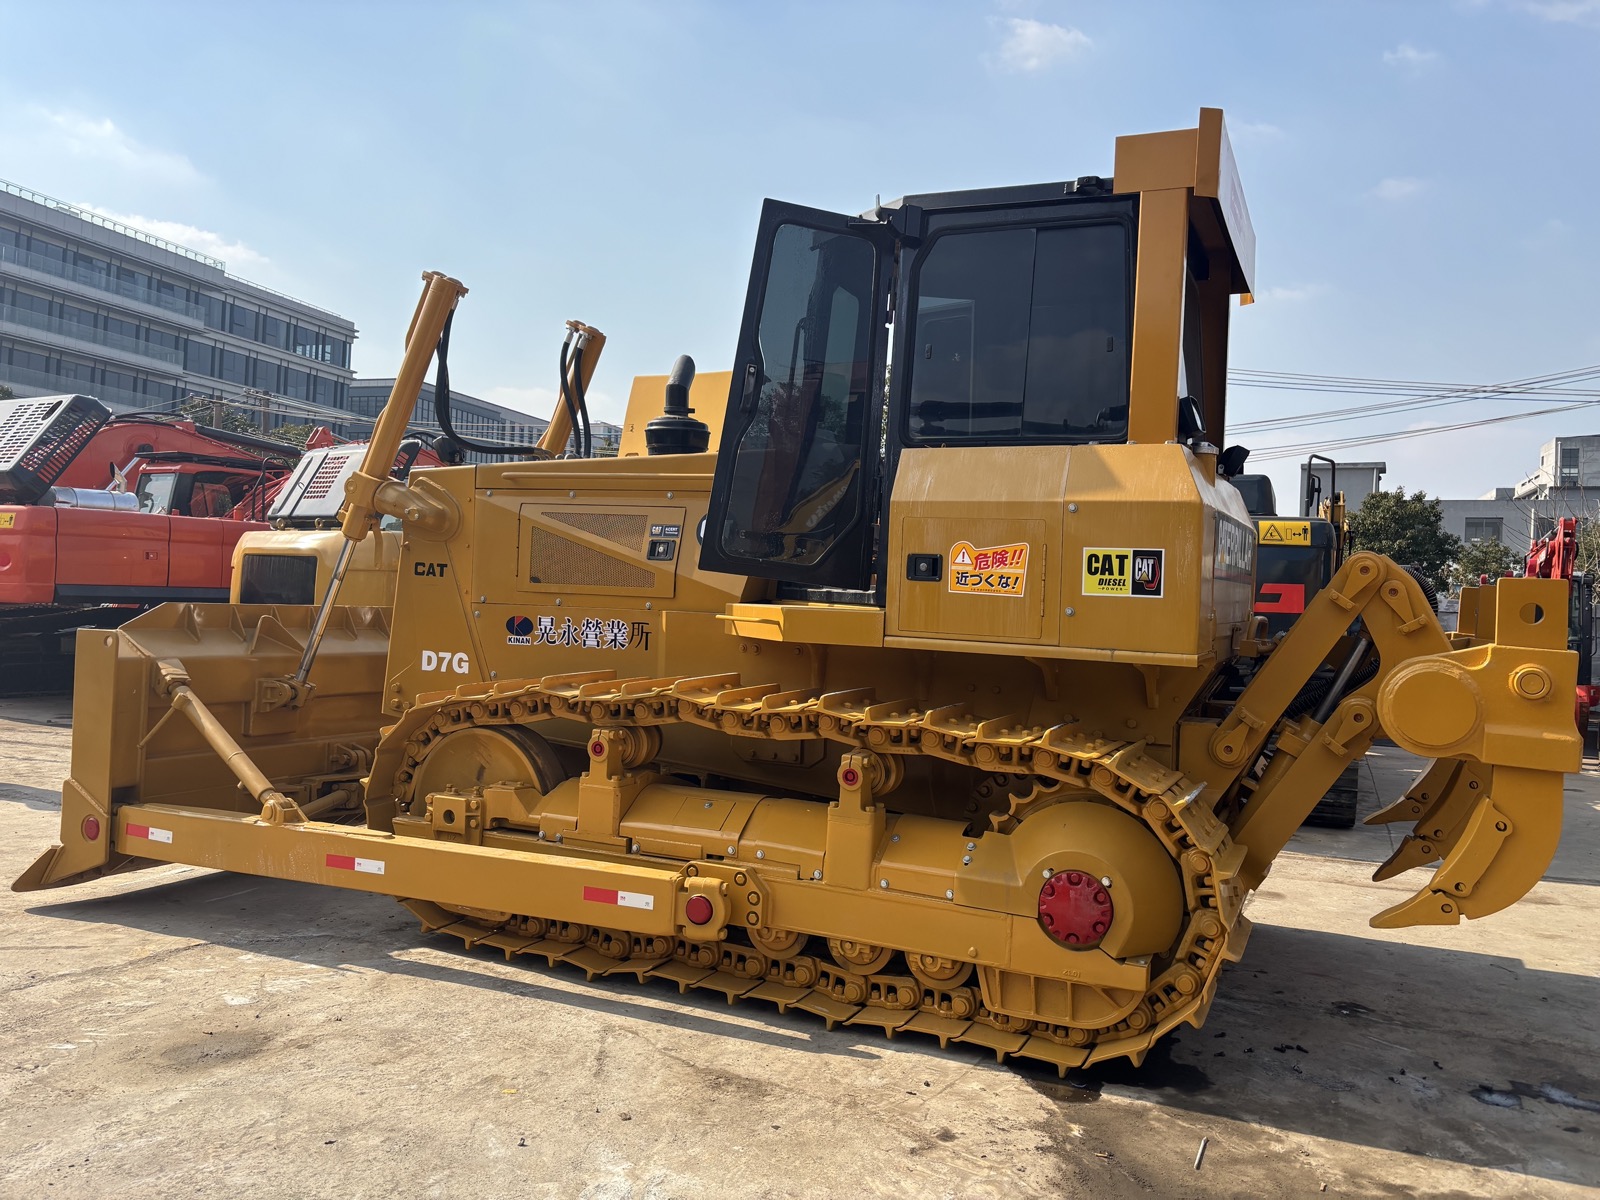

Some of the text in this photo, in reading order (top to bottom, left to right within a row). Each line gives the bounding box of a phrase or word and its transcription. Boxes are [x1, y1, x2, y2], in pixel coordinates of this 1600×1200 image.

[414, 562, 448, 577] CAT
[1087, 553, 1128, 576] CAT
[1135, 557, 1154, 581] CAT
[1098, 578, 1126, 587] DIESEL
[508, 636, 531, 644] KINAN
[534, 616, 652, 650] 晃永營業所
[421, 650, 469, 674] D7G
